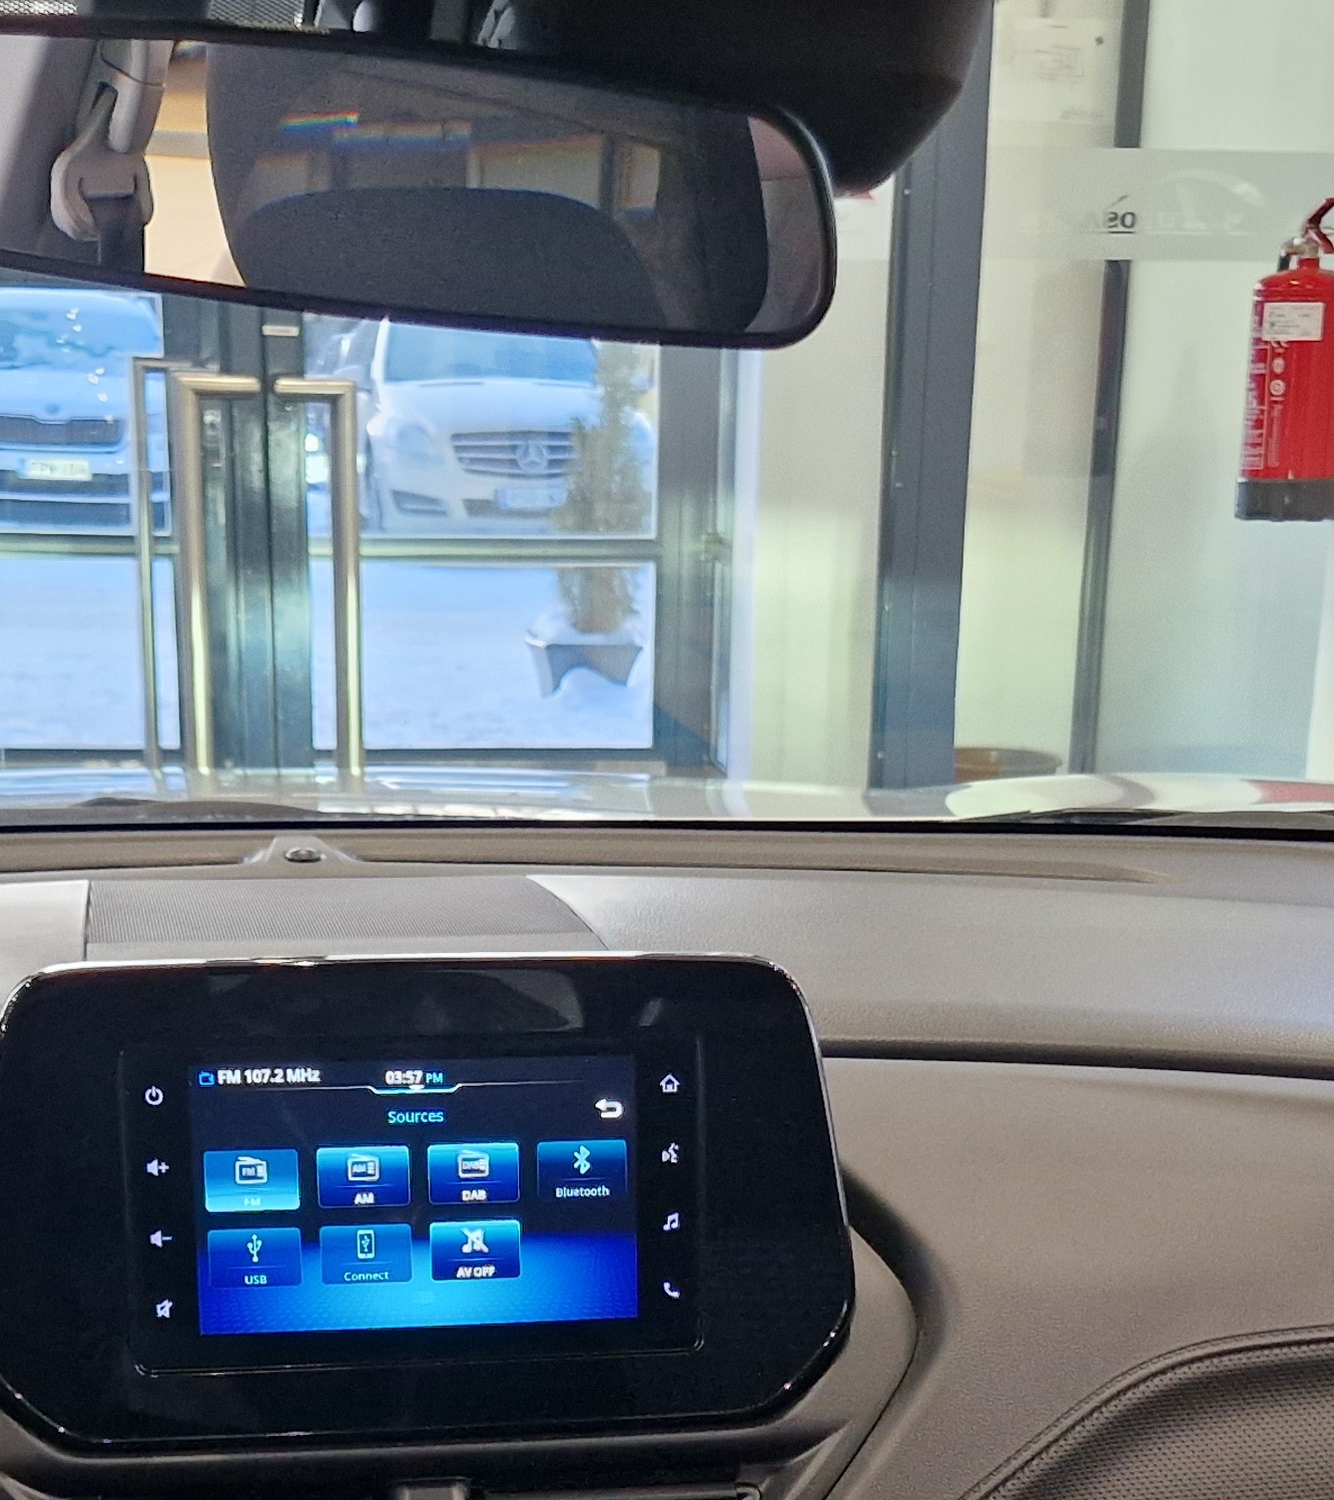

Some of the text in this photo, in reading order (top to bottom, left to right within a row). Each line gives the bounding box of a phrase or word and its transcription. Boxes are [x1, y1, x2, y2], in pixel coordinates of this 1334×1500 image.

[217, 1067, 321, 1085] FM 107.2 MHz
[384, 1070, 443, 1085] 03:57 PM
[387, 1109, 445, 1125] Sources
[462, 1190, 487, 1201] DAB
[556, 1184, 610, 1198] Bluetooth
[354, 1192, 375, 1205] AM
[244, 1275, 267, 1285] USB
[344, 1271, 389, 1281] Connect
